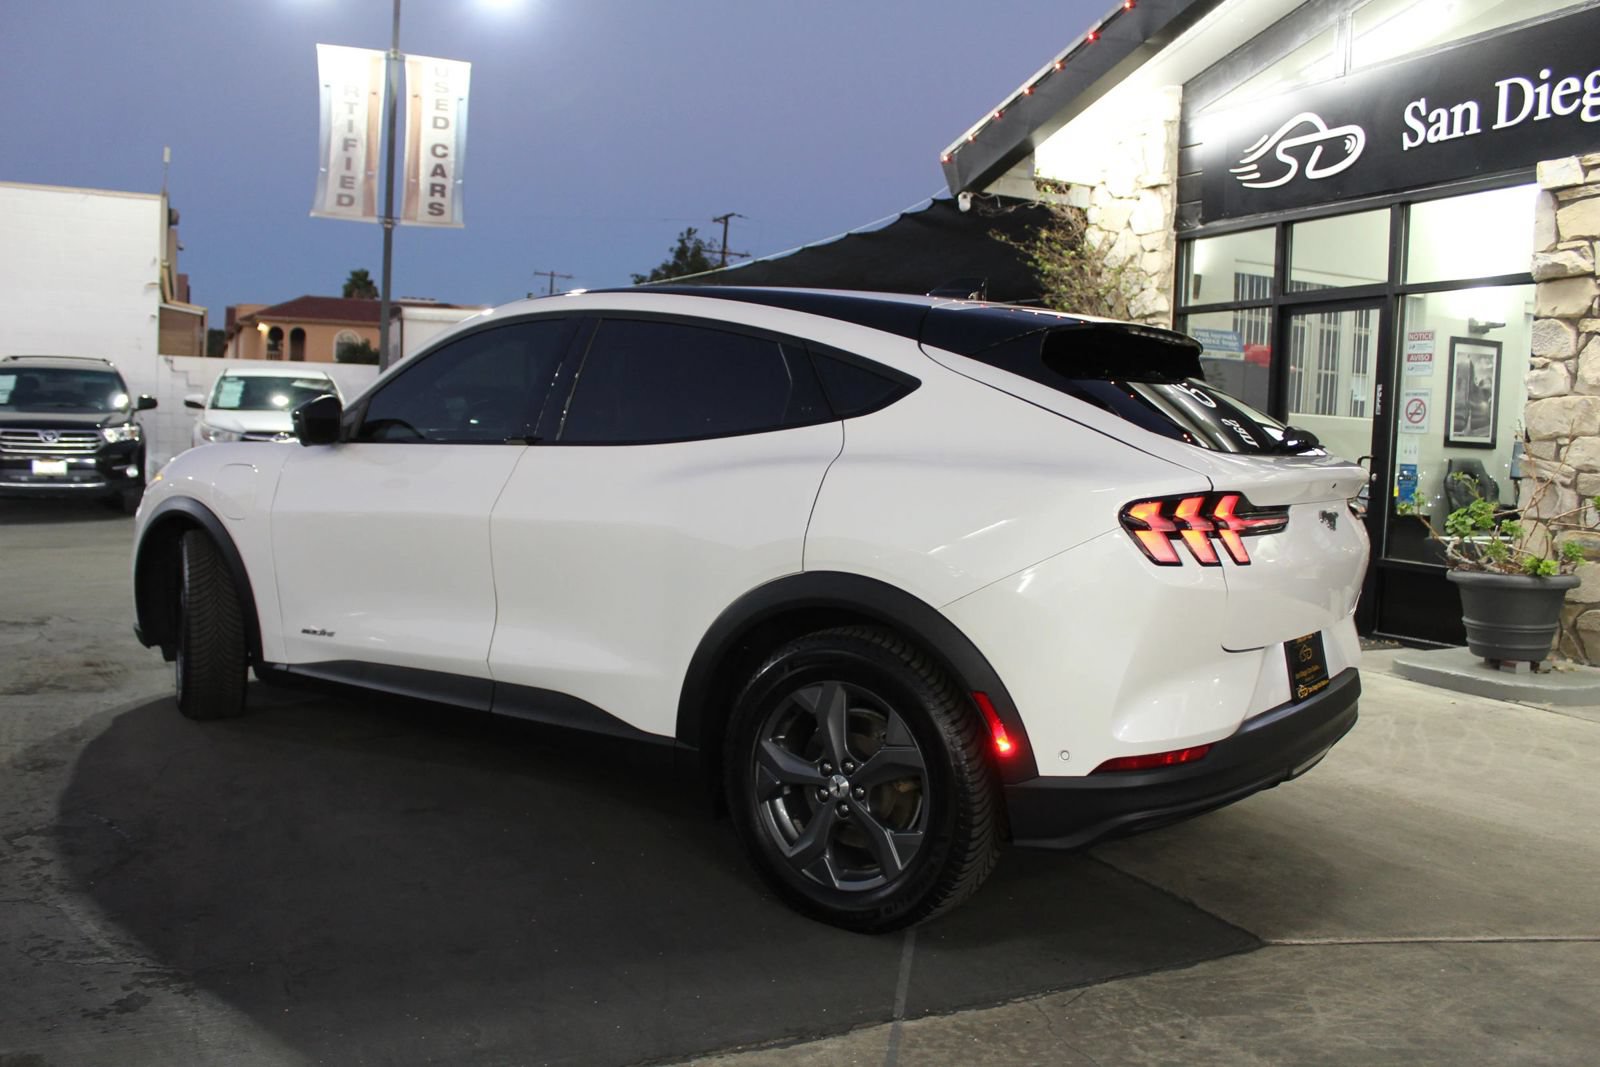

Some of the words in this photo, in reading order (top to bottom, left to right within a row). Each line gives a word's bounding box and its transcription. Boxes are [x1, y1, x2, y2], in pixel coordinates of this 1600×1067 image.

[434, 66, 450, 130] USED
[1402, 97, 1482, 151] San
[336, 85, 360, 207] RTIFIED
[428, 143, 448, 217] CARS
[1408, 333, 1433, 341] NOTICE
[1410, 353, 1430, 362] AVISO
